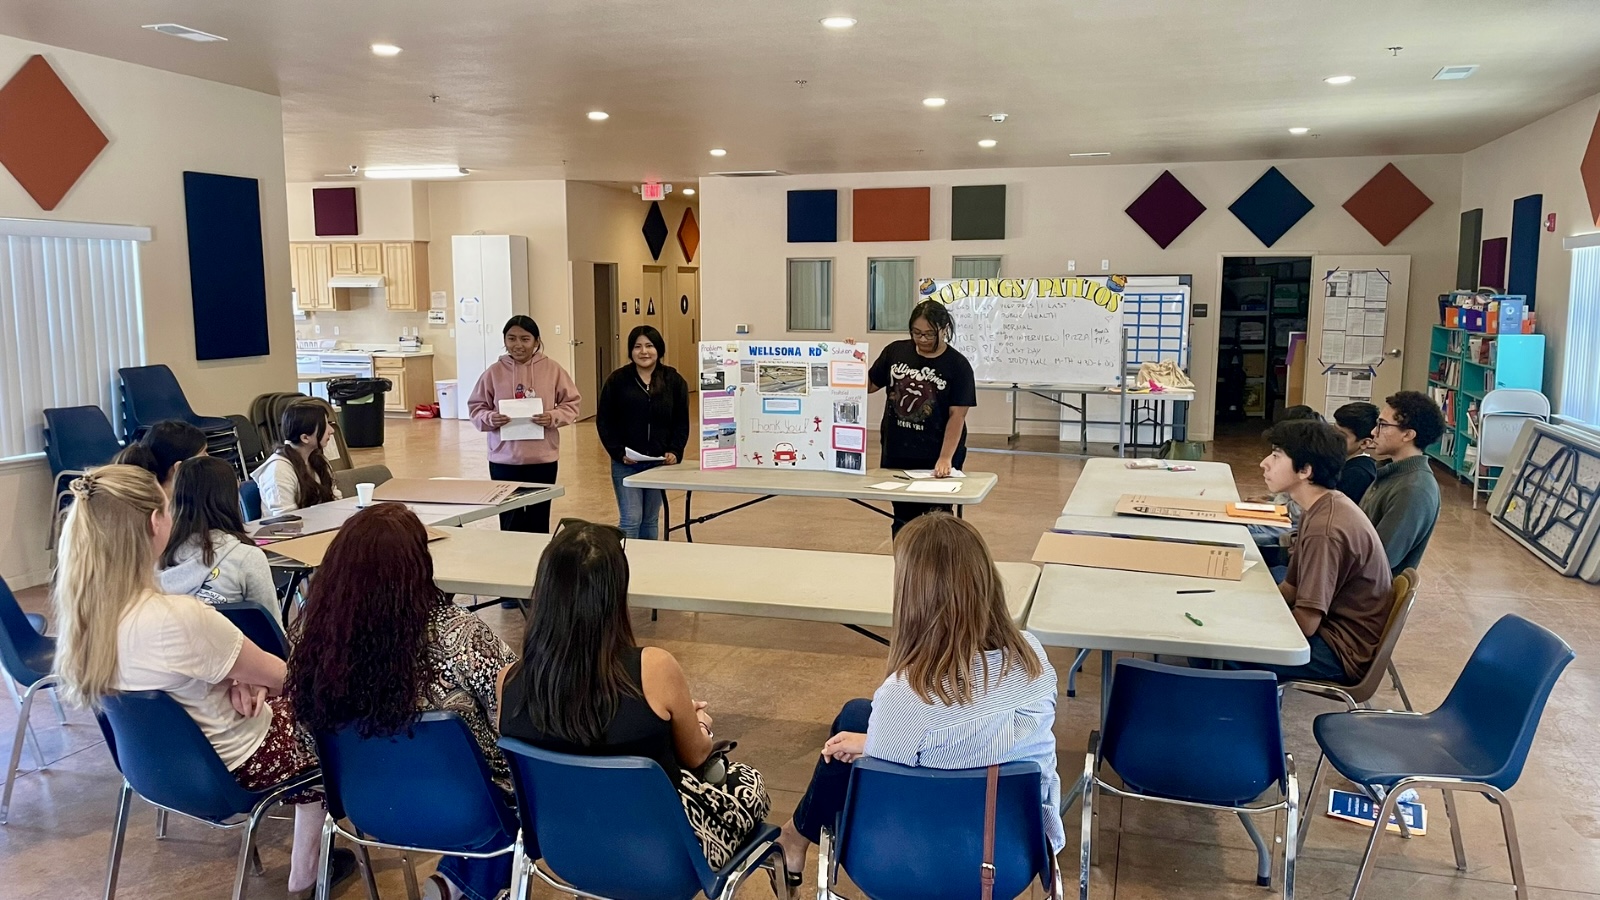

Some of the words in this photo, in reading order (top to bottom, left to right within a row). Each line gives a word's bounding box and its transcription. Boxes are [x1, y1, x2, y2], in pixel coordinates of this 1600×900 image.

[1037, 278, 1123, 312] PATITOS
[1027, 311, 1057, 319] HEALTH
[1016, 334, 1060, 342] INTERVIEW
[1065, 333, 1090, 341] PIZZA
[700, 344, 723, 353] Problem
[748, 346, 802, 357] WELLSONA
[808, 346, 822, 357] RD
[889, 362, 920, 388] Rolling
[915, 366, 948, 391] Stones
[750, 417, 780, 432] Thank
